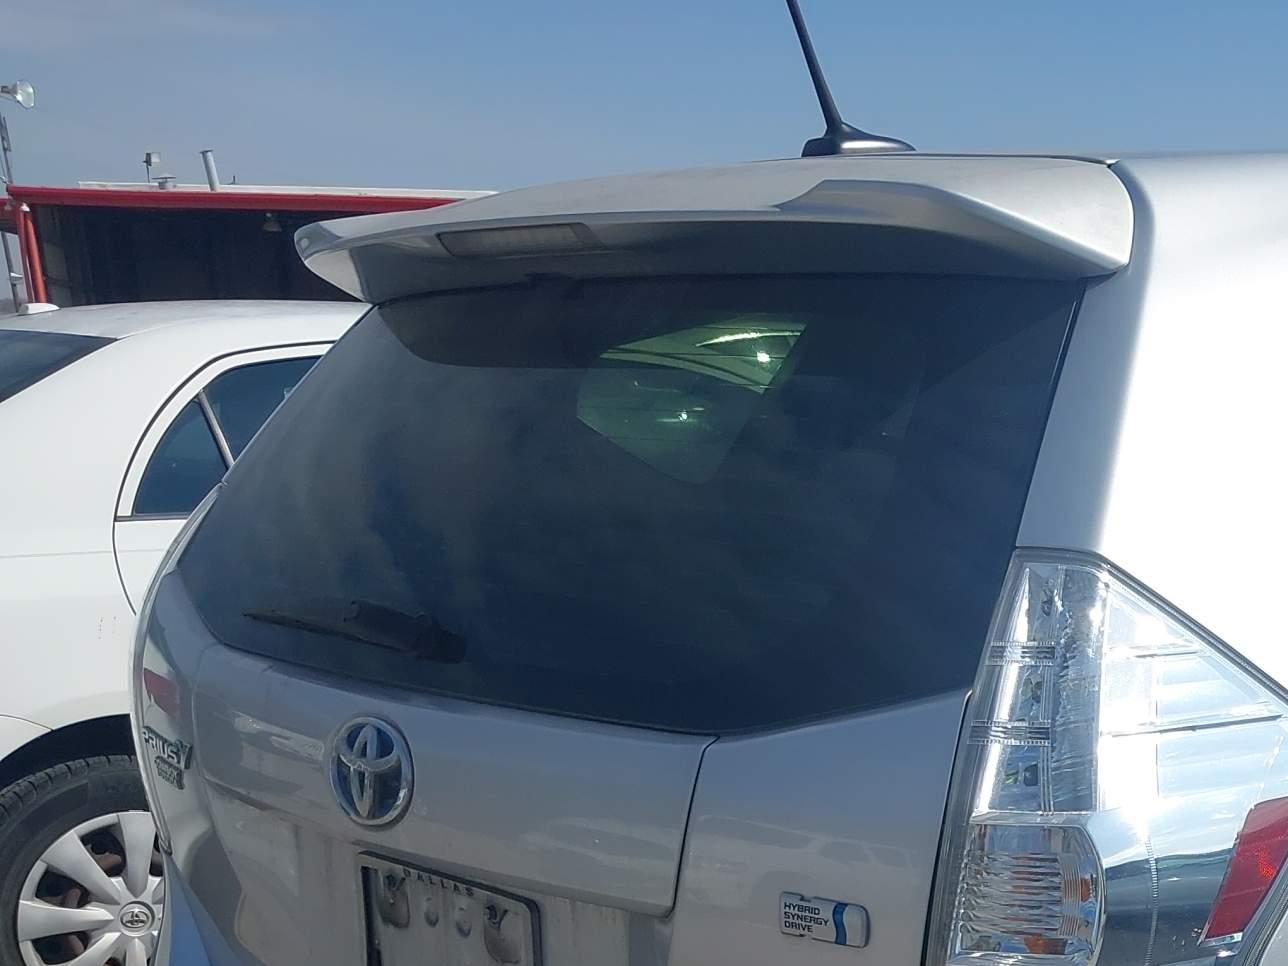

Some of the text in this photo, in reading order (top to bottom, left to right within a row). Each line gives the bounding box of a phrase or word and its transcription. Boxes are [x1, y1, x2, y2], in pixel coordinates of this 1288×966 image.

[142, 729, 178, 764] PRIUS
[402, 867, 475, 897] DALLAS
[783, 901, 821, 916] HYBRID
[783, 911, 829, 927] SYNERGY
[784, 920, 814, 933] DRIVE
